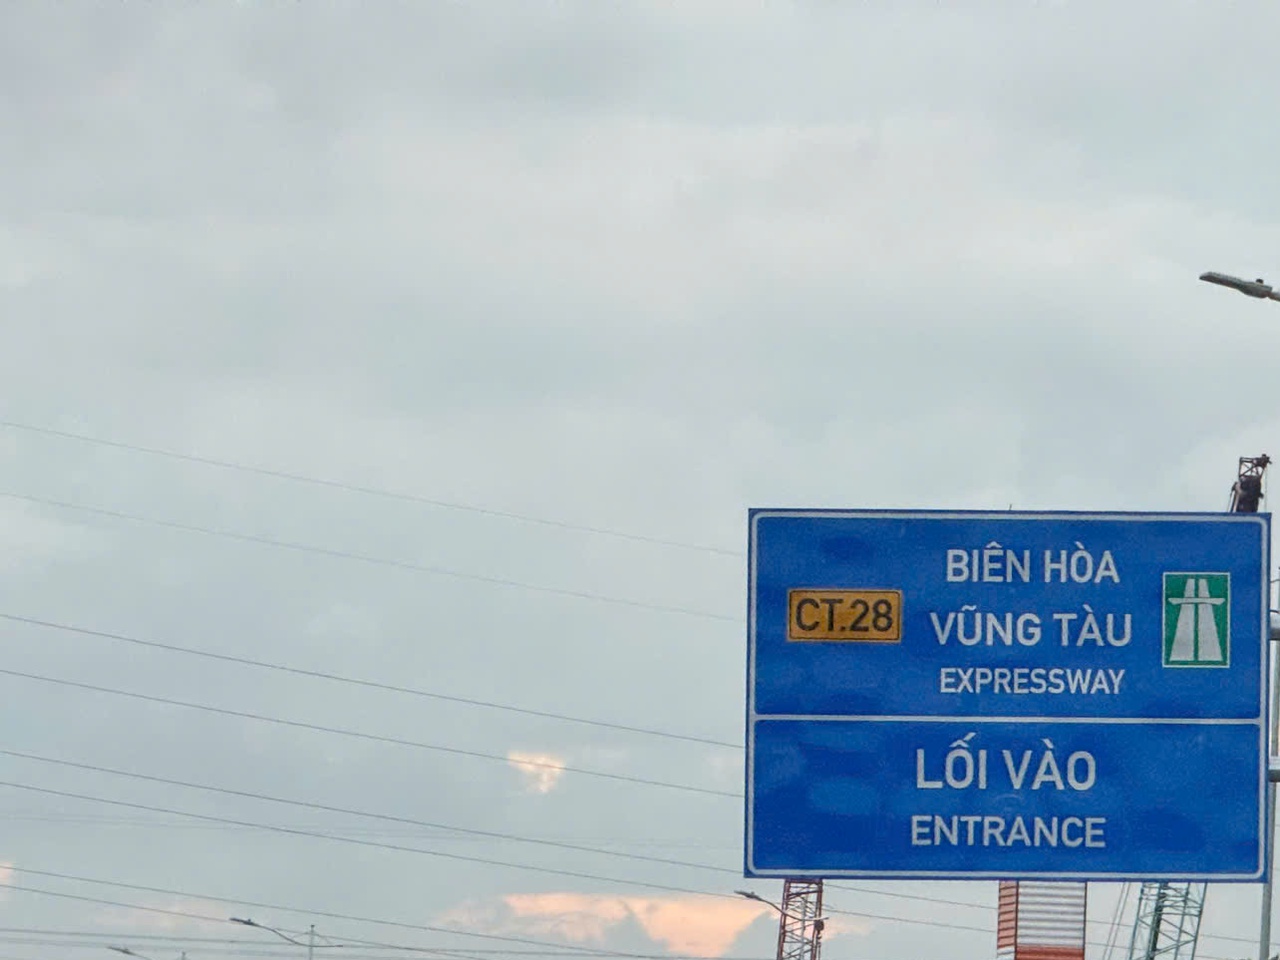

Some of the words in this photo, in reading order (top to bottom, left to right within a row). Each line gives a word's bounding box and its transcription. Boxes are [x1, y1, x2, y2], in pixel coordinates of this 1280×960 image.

[946, 541, 1030, 583] BIÊN
[1044, 541, 1120, 583] HÒA
[795, 599, 893, 633] CT.28
[930, 604, 1041, 647] VŨNG
[1053, 604, 1132, 647] TÀU
[940, 667, 1126, 694] EXPRESSWAY
[916, 732, 987, 790] LỐI
[1002, 738, 1096, 791] VÀO
[911, 815, 1106, 848] ENTRANCE
